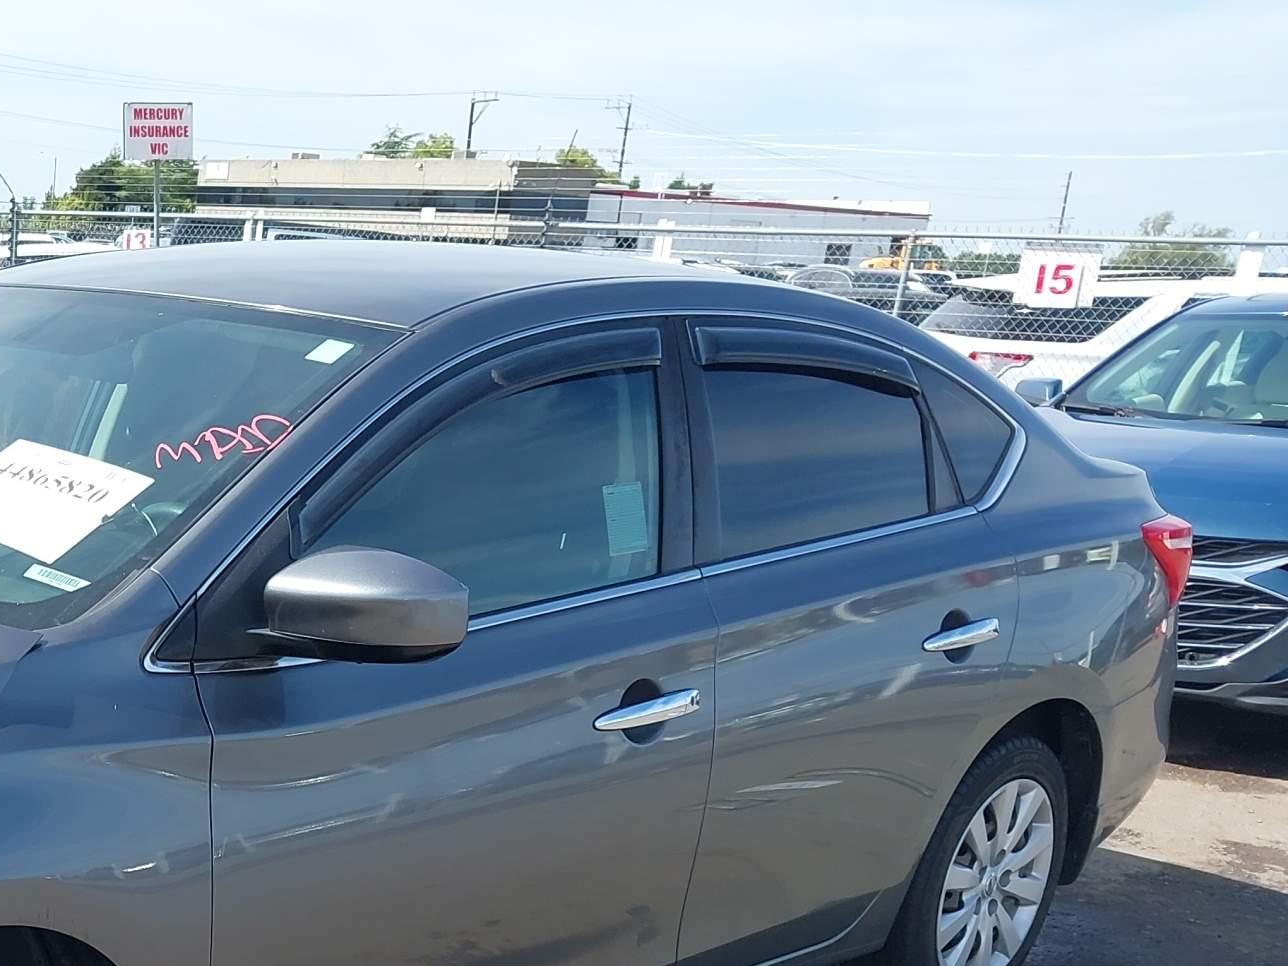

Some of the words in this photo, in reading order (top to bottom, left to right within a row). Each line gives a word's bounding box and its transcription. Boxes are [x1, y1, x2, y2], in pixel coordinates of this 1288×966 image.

[133, 107, 185, 121] MERCURY
[129, 125, 190, 138] INSURANCE
[150, 143, 169, 156] VIC
[1034, 264, 1075, 295] 15
